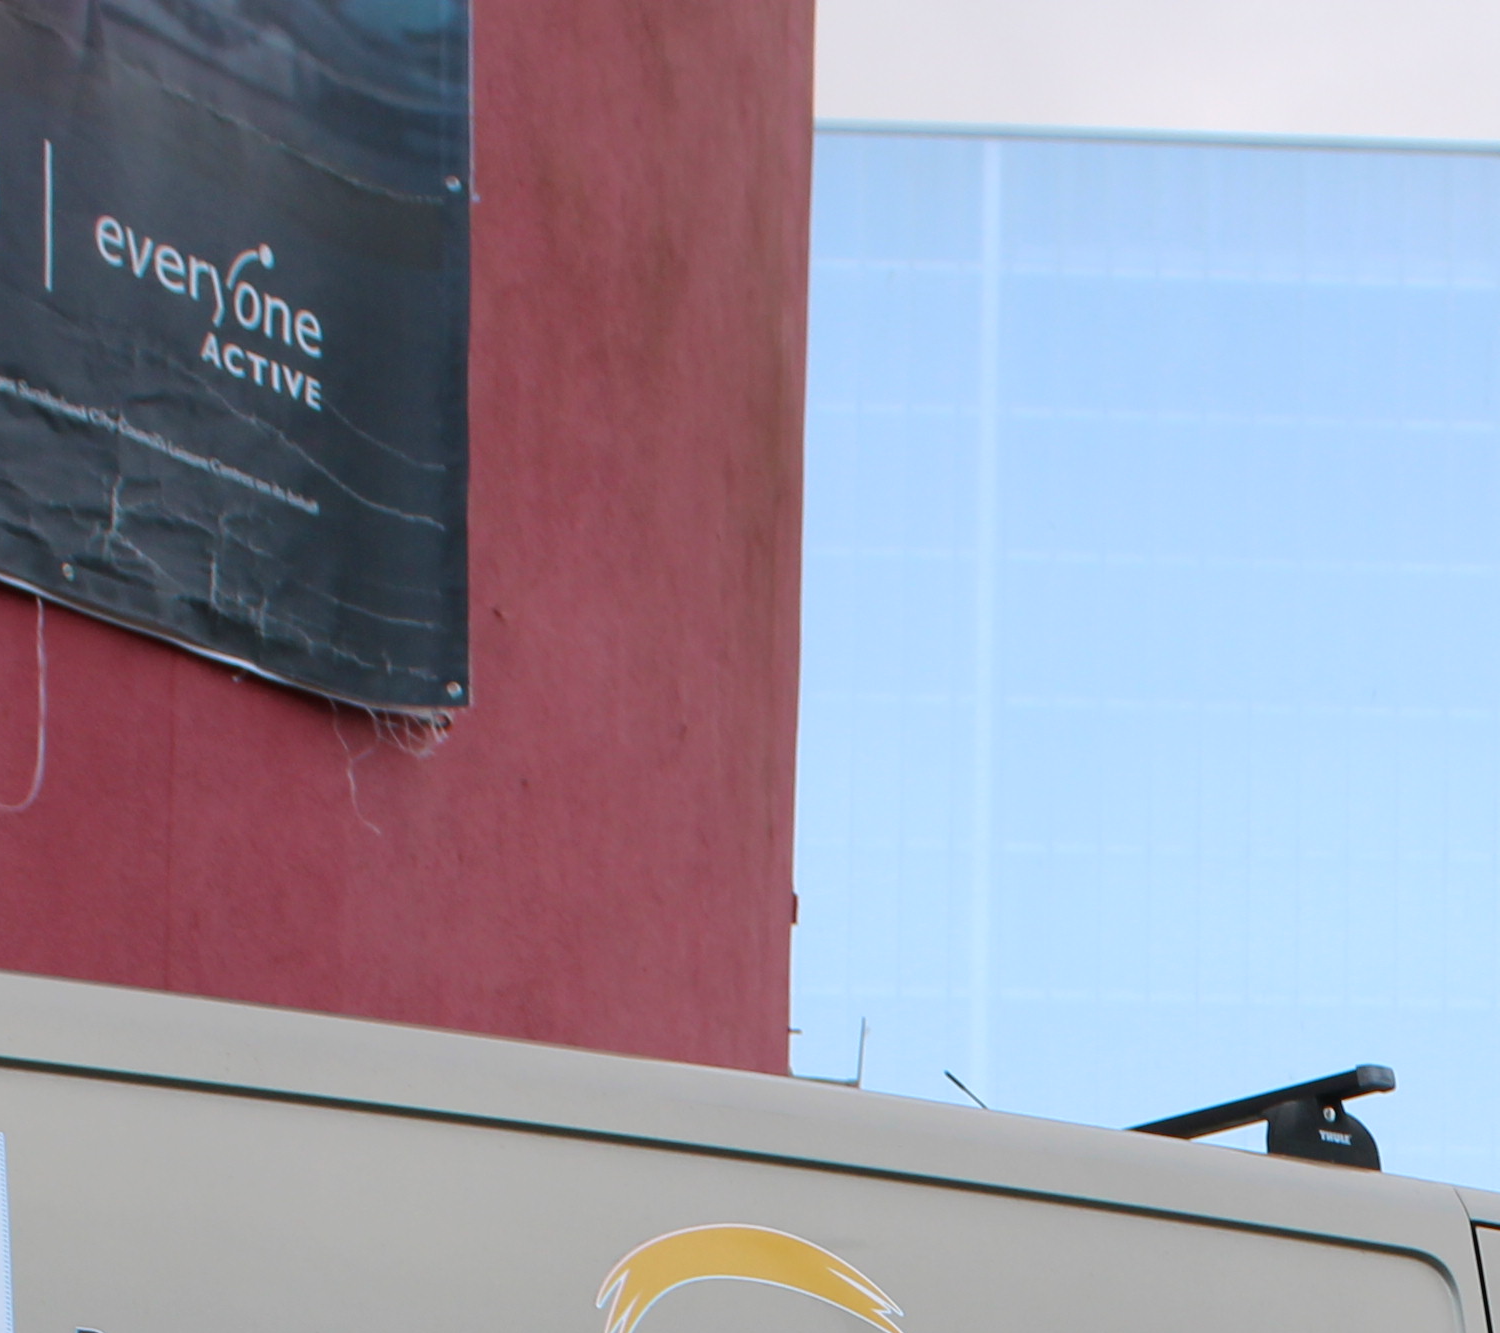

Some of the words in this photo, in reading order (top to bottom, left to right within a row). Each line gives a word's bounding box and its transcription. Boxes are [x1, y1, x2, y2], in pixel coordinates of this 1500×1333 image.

[95, 215, 323, 358] everyone
[200, 331, 322, 412] ACTIVE
[1318, 1129, 1352, 1146] THULE
